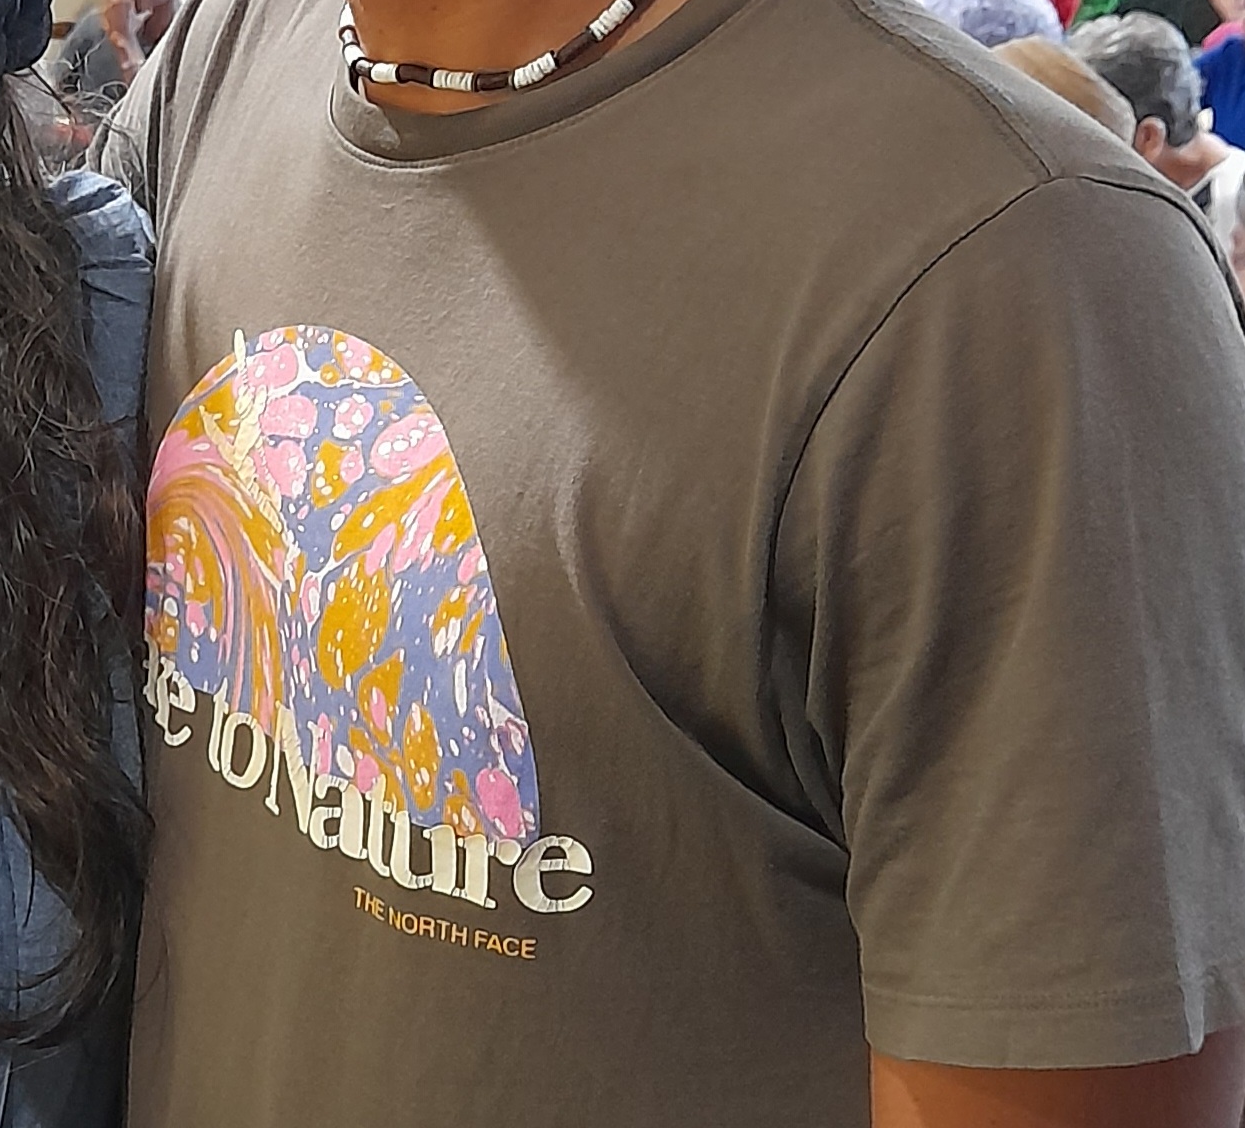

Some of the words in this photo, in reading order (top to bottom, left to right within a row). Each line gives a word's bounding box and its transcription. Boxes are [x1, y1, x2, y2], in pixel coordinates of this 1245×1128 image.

[208, 677, 267, 789] to
[264, 699, 594, 913] Nature
[353, 886, 385, 922] THE
[388, 905, 468, 947] NORTH
[473, 929, 538, 960] FACE
